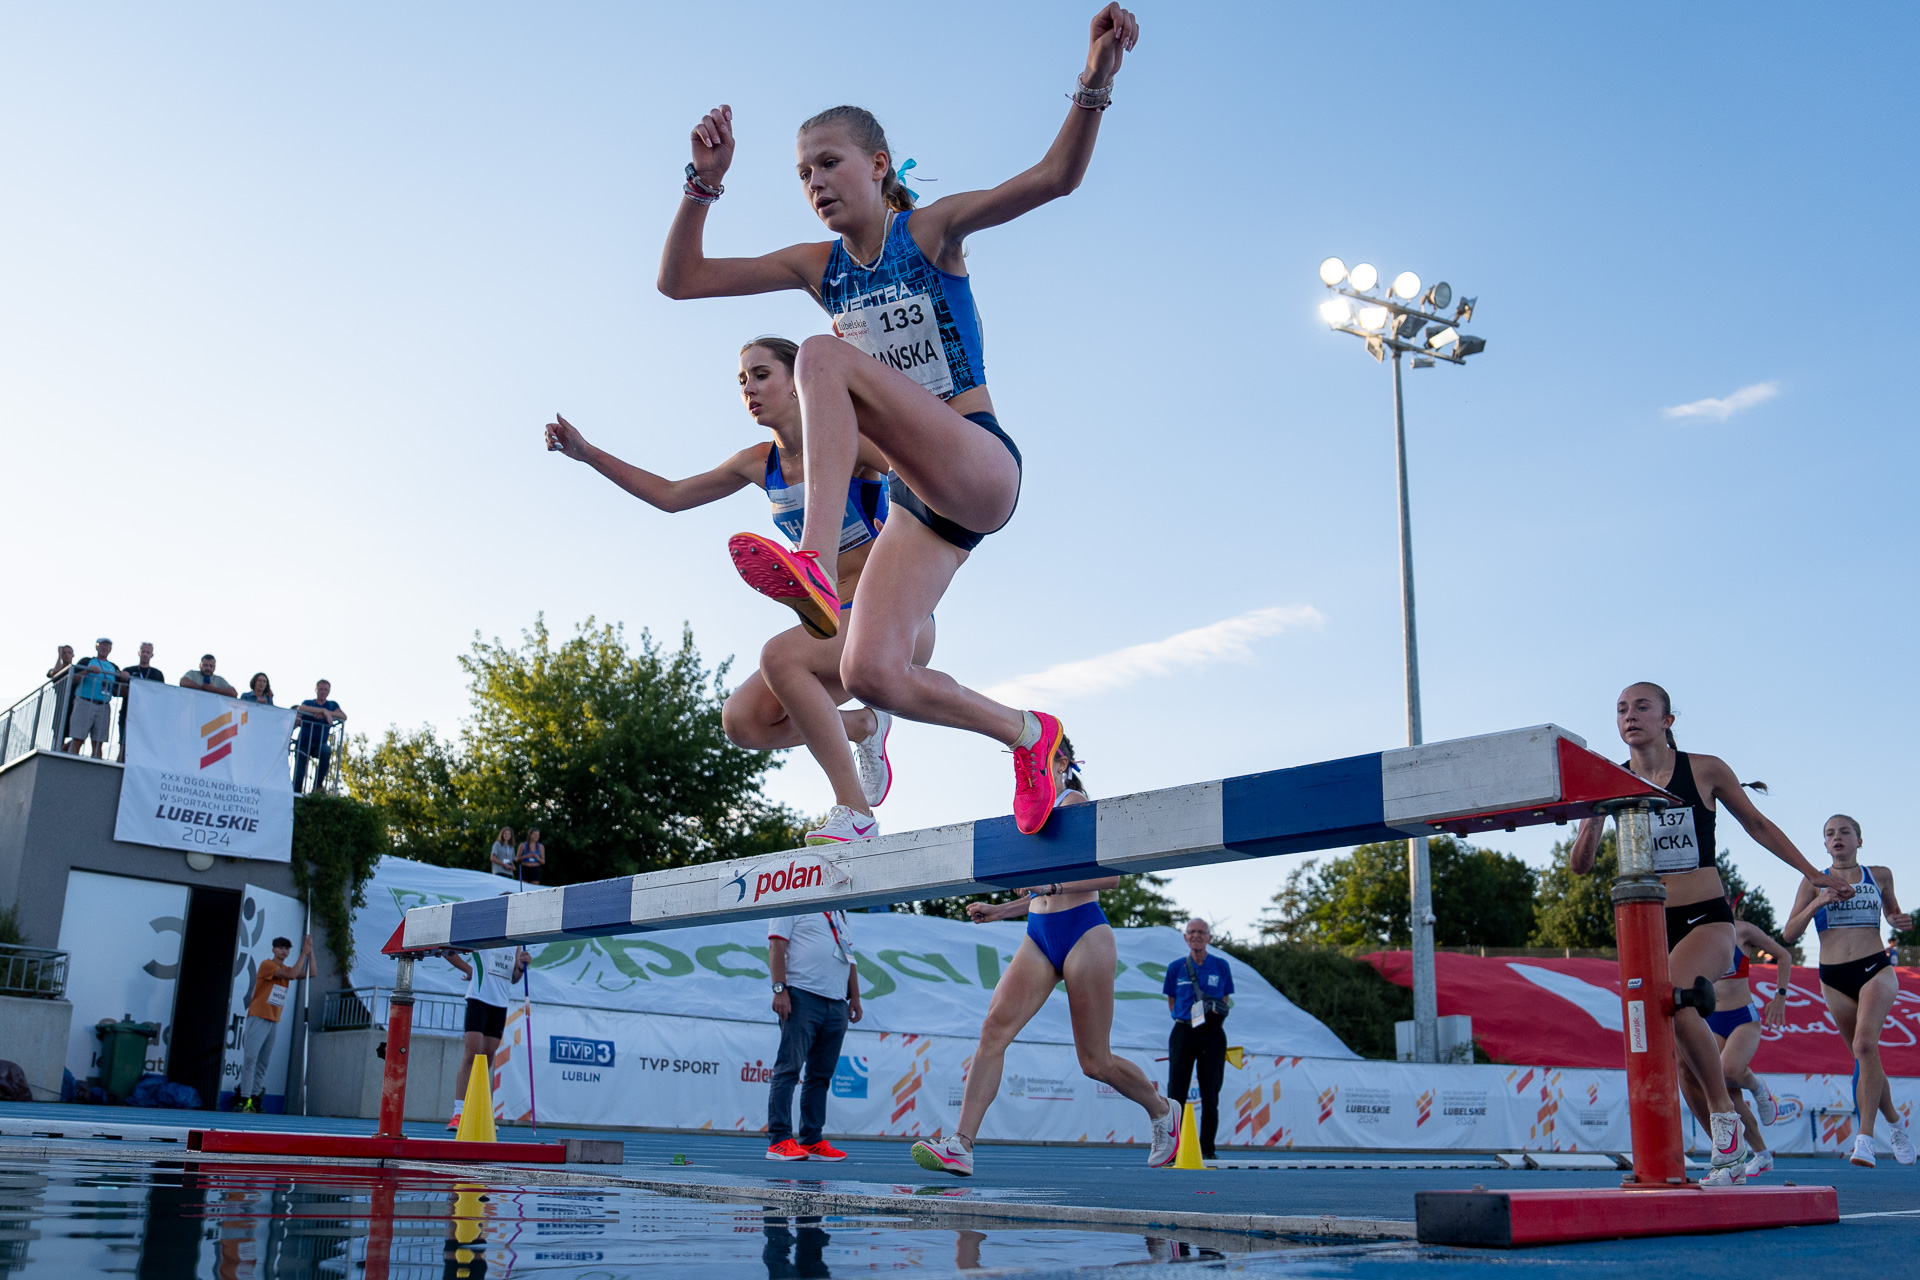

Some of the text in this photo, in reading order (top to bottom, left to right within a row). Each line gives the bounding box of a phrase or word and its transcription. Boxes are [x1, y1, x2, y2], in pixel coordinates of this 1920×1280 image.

[879, 303, 925, 333] 133
[872, 339, 939, 371] AŃSKA
[161, 772, 261, 796] XXX OGÓLNOPOLSKA
[160, 782, 260, 806] OLIMPIADA MŁODZIEŻY
[159, 793, 259, 816] W SPORTACH LETNICH
[155, 804, 260, 833] LUBELSKIE
[1658, 812, 1686, 827] 137
[182, 827, 231, 847] 2024
[1653, 834, 1694, 851] ICKA
[753, 860, 824, 904] polan
[1855, 885, 1875, 894] 816
[1827, 900, 1879, 911] GRZELCZAK
[1632, 1017, 1644, 1049] polanik
[639, 1056, 720, 1075] TVP SPORT
[562, 1070, 601, 1083] LUBLIN
[1345, 1104, 1391, 1114] LUBELSKIE
[1443, 1107, 1487, 1116] LUBELSKIE
[1357, 1114, 1380, 1124] 2024
[1455, 1116, 1477, 1126] 2024
